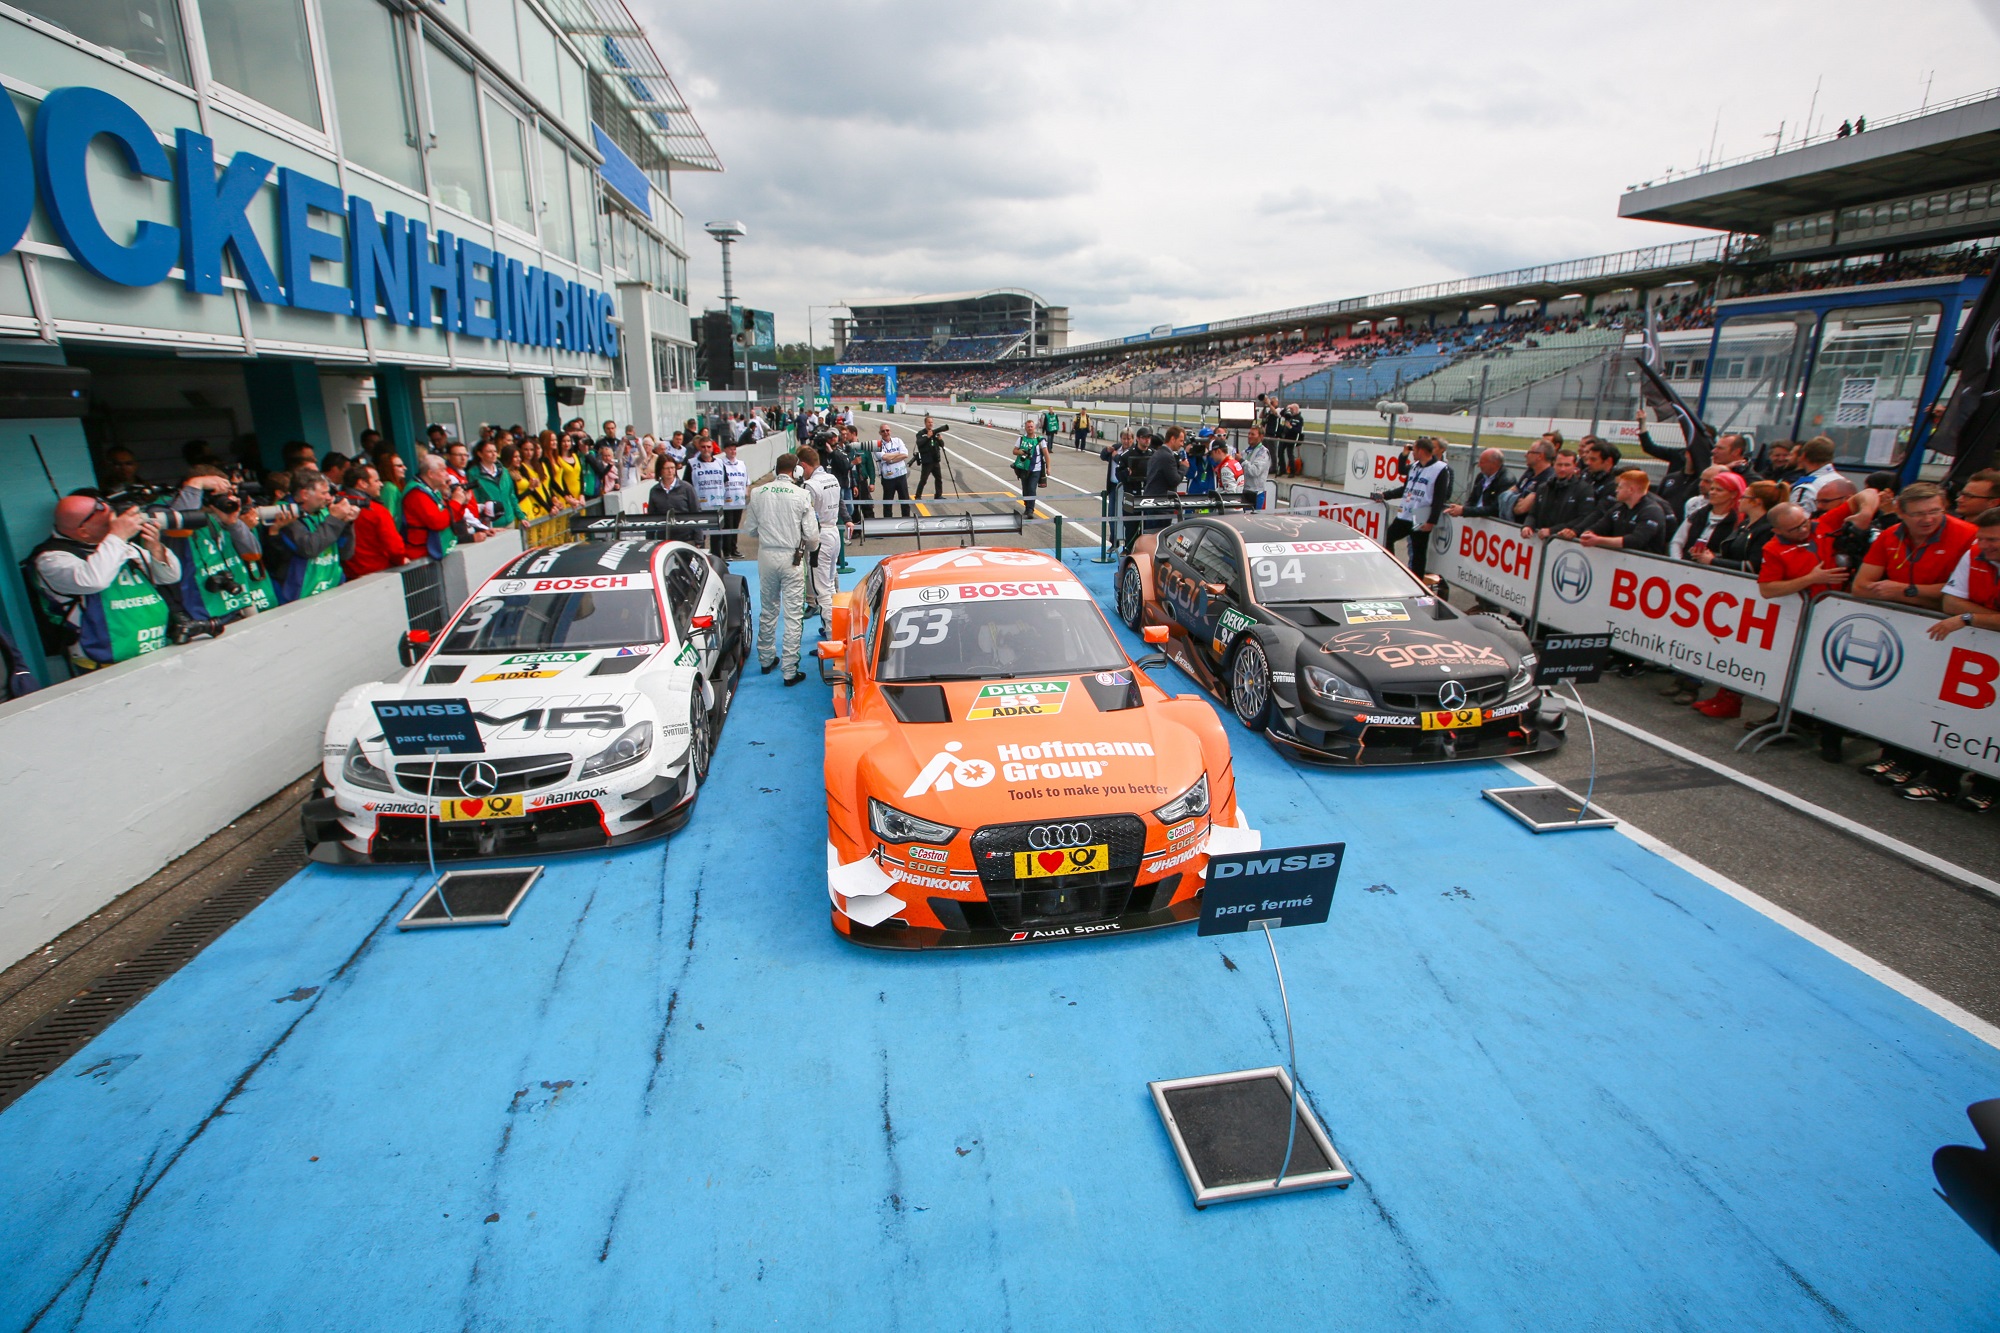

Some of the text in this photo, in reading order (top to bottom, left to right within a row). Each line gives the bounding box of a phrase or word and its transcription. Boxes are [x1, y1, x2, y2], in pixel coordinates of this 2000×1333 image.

[0, 83, 618, 358] CKENHEIMRING
[842, 366, 874, 374] ultimate
[1496, 421, 1514, 429] BOSCH
[1620, 427, 1641, 437] BOSC
[1319, 499, 1379, 540] BOSCH
[1291, 541, 1364, 553] BOSCH
[1459, 525, 1534, 580] BOSCH
[1256, 558, 1306, 587] 94
[533, 576, 628, 592] BOSCH
[959, 583, 1059, 599] BOSCH
[1457, 566, 1527, 608] Technik fürs Leben
[456, 595, 504, 633] 3
[1345, 602, 1398, 610] DEKRA
[1361, 609, 1392, 617] 94
[1609, 568, 1780, 651] BOSCH
[889, 608, 953, 649] 53
[1222, 610, 1249, 632] DEKRA
[1546, 637, 1609, 650] DMSB
[511, 653, 577, 664] DEKRA
[1376, 640, 1505, 668] gooix
[1606, 620, 1766, 687] Technik fürs Leben
[523, 663, 539, 671] 3
[1417, 657, 1462, 667] watches
[1542, 662, 1594, 675] parc fermé
[495, 671, 541, 681] ADAC
[987, 682, 1063, 696] DEKRA
[1000, 694, 1039, 707] 53
[377, 704, 466, 717] DMSB
[992, 705, 1043, 717] ADAC
[395, 731, 466, 745] parc fermé
[997, 740, 1155, 762] Hoffmann
[1008, 783, 1168, 800] Tools to make you better
[1174, 822, 1195, 838] Castrol
[1169, 836, 1196, 852] EDGE
[917, 848, 947, 862] Castrol
[908, 861, 947, 875] EDGE
[1214, 852, 1336, 879] DMSB
[1215, 894, 1313, 918] parc fermé
[1032, 922, 1121, 938] Audi Sport
